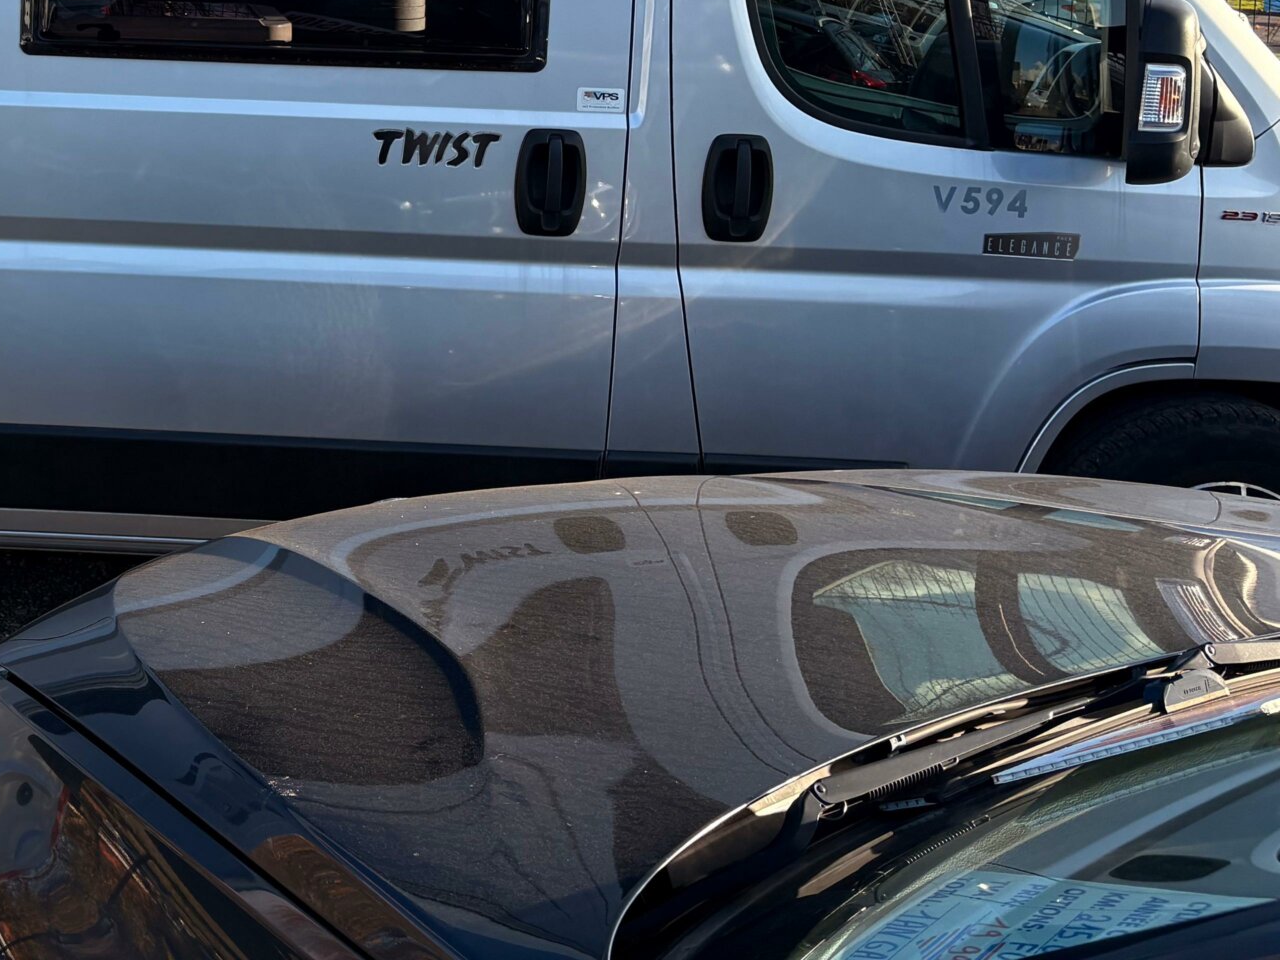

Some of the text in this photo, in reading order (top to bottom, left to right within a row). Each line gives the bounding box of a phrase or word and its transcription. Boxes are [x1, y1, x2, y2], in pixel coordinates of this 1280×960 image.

[593, 92, 619, 101] VPS
[373, 127, 502, 168] TWIST
[987, 237, 1072, 256] ELEGANCE
